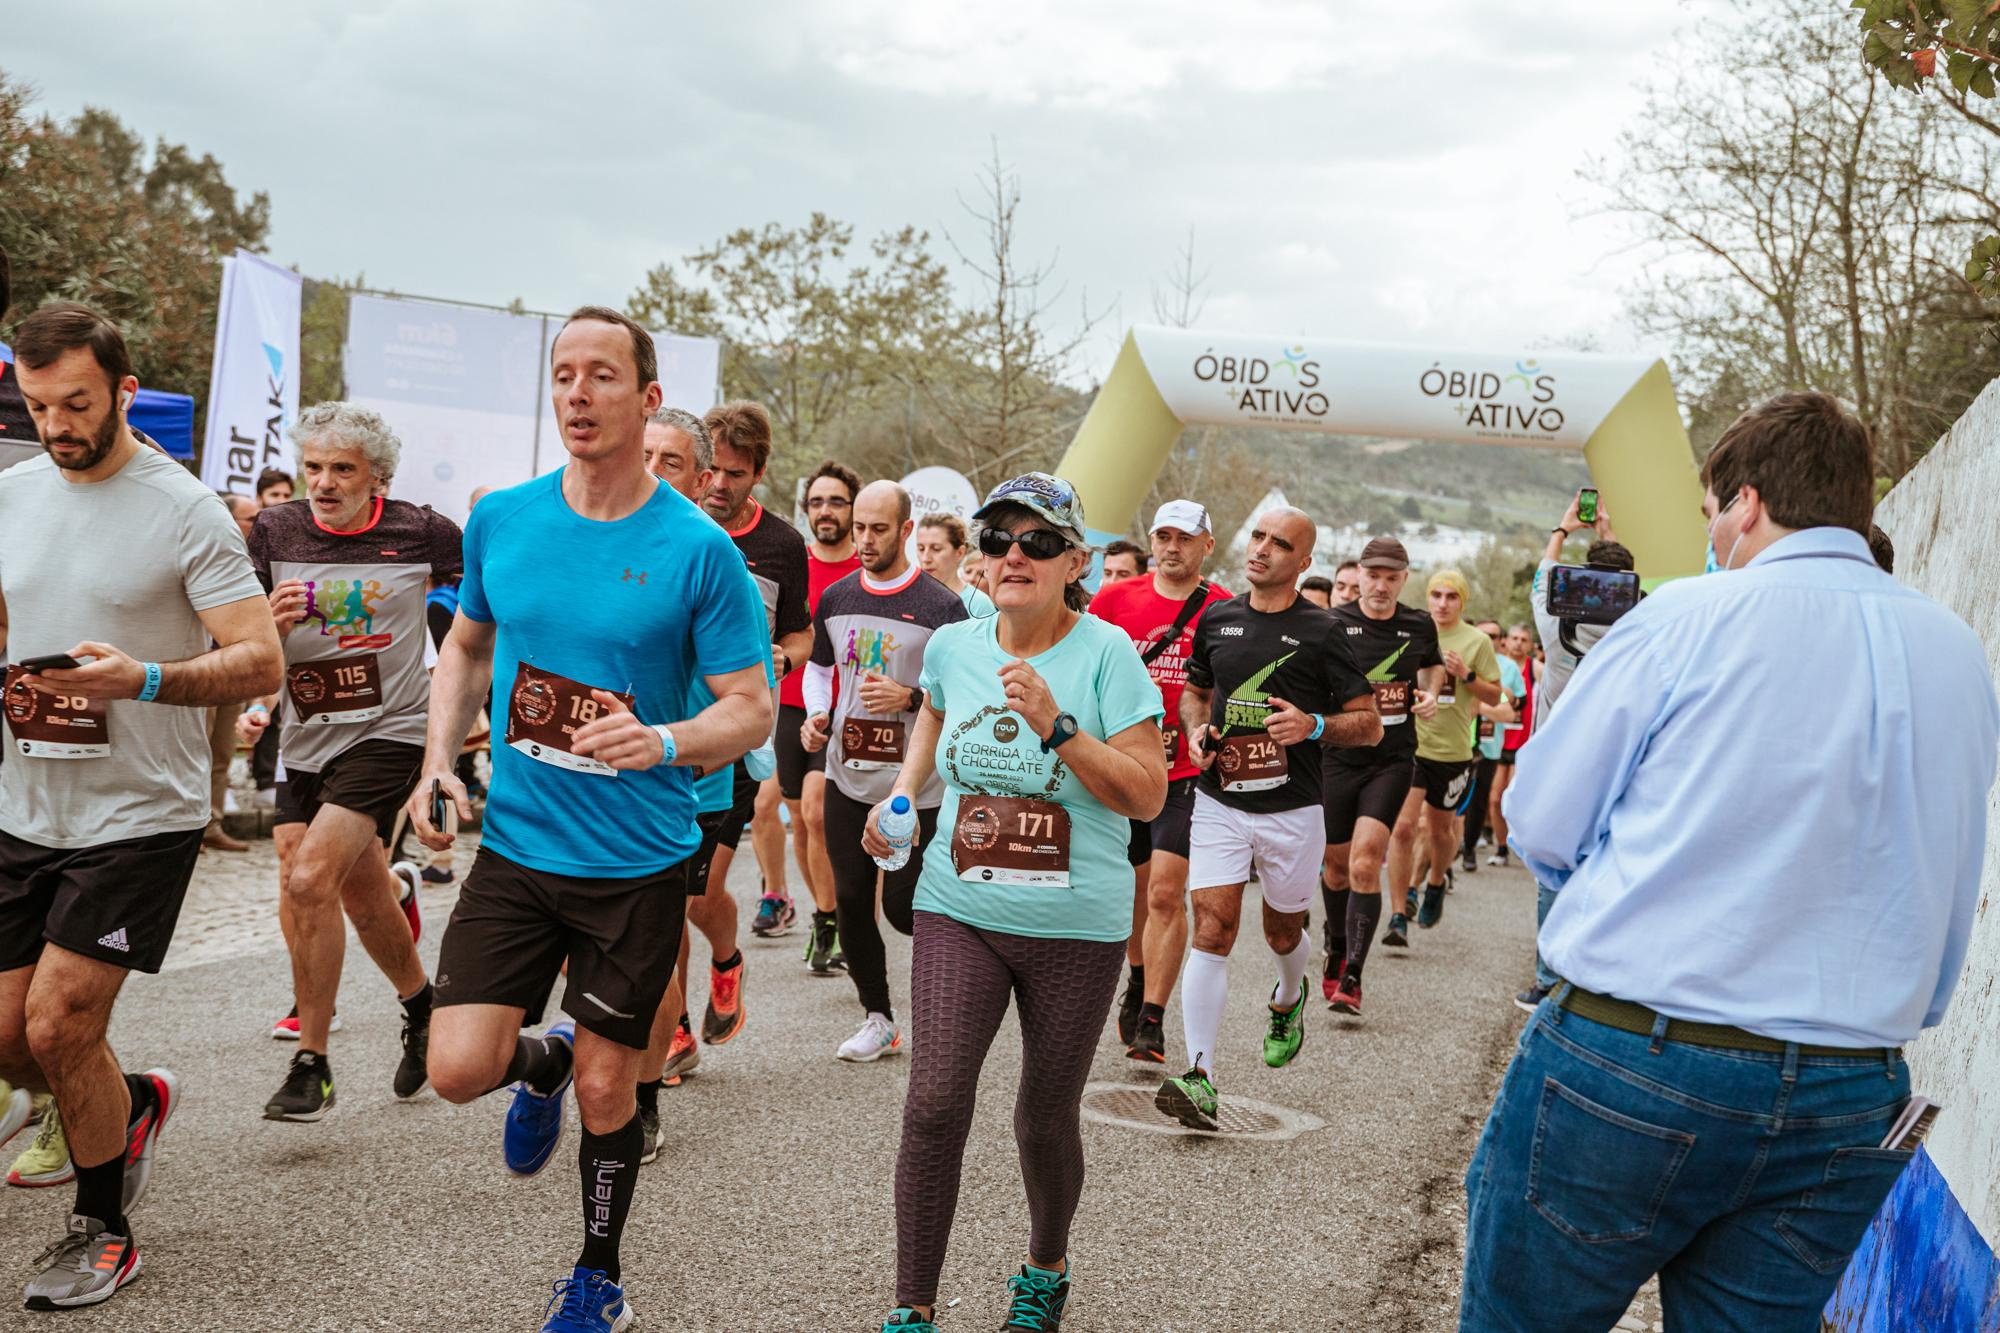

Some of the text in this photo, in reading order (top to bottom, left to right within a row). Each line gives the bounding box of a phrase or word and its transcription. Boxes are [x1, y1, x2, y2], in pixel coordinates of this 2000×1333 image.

[335, 665, 367, 686] 115
[1380, 687, 1405, 701] 246
[570, 695, 608, 723] 18
[872, 727, 894, 744] 70
[962, 742, 1045, 762] CORRIDA DO
[1247, 742, 1277, 760] 214
[961, 755, 1043, 775] CHOCOLATE
[1017, 811, 1054, 839] 171
[1008, 842, 1032, 853] 10km
[97, 937, 130, 952] adidas
[589, 1158, 625, 1237] kalenji
